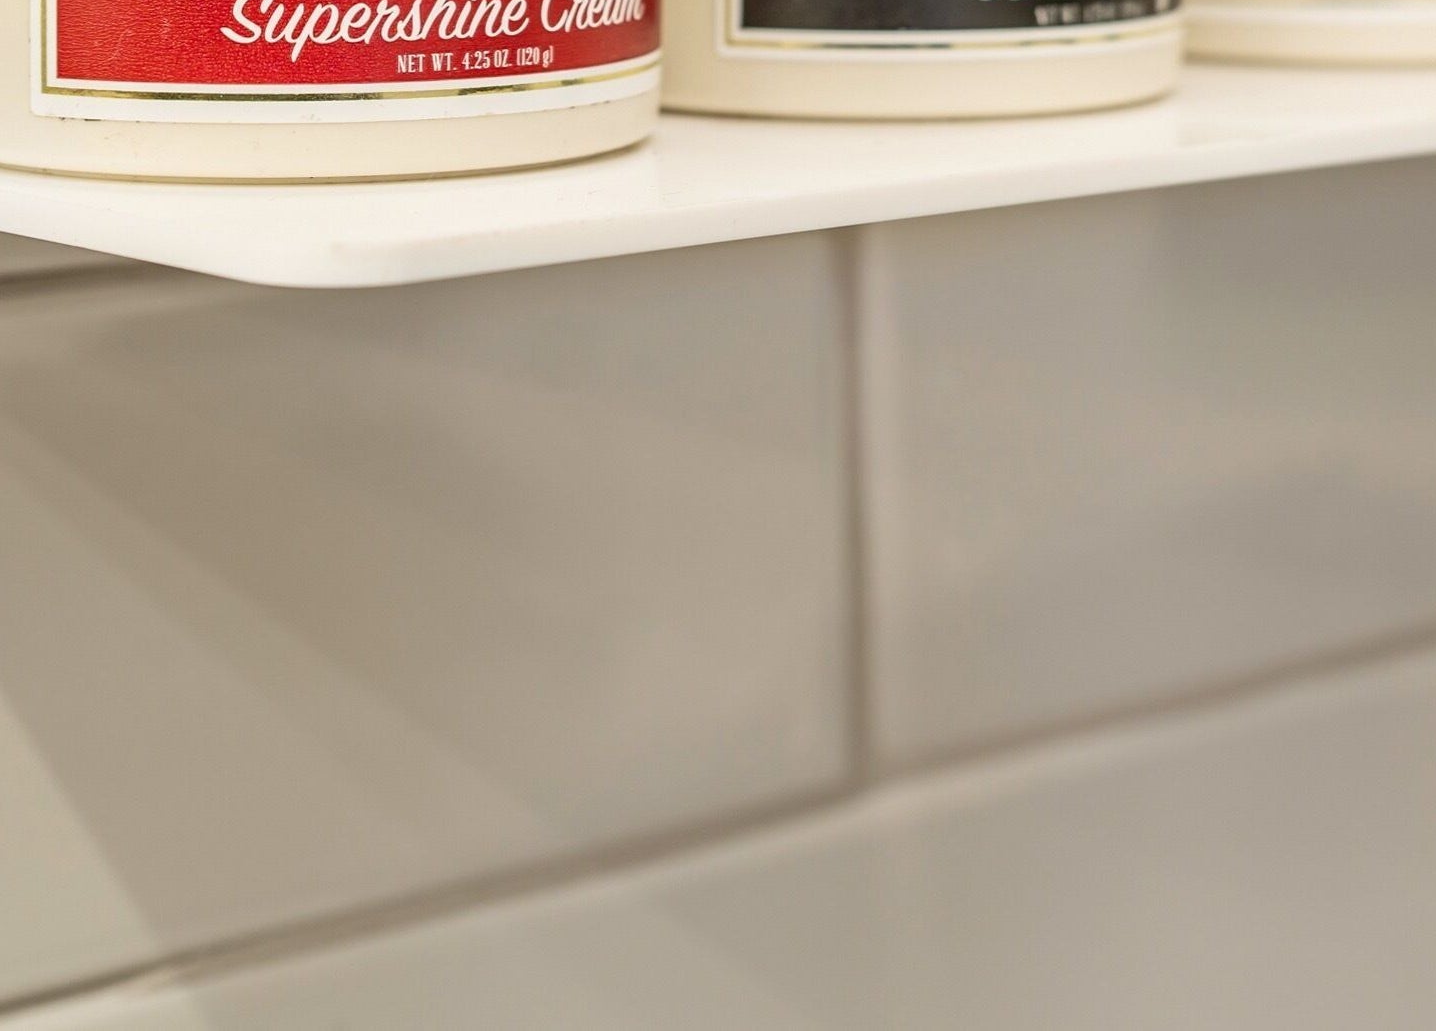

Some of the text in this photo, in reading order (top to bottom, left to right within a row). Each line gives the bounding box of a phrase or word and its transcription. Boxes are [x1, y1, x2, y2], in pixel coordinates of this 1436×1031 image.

[397, 54, 425, 73] NET
[431, 52, 457, 71] WT.
[462, 50, 490, 70] 4.25
